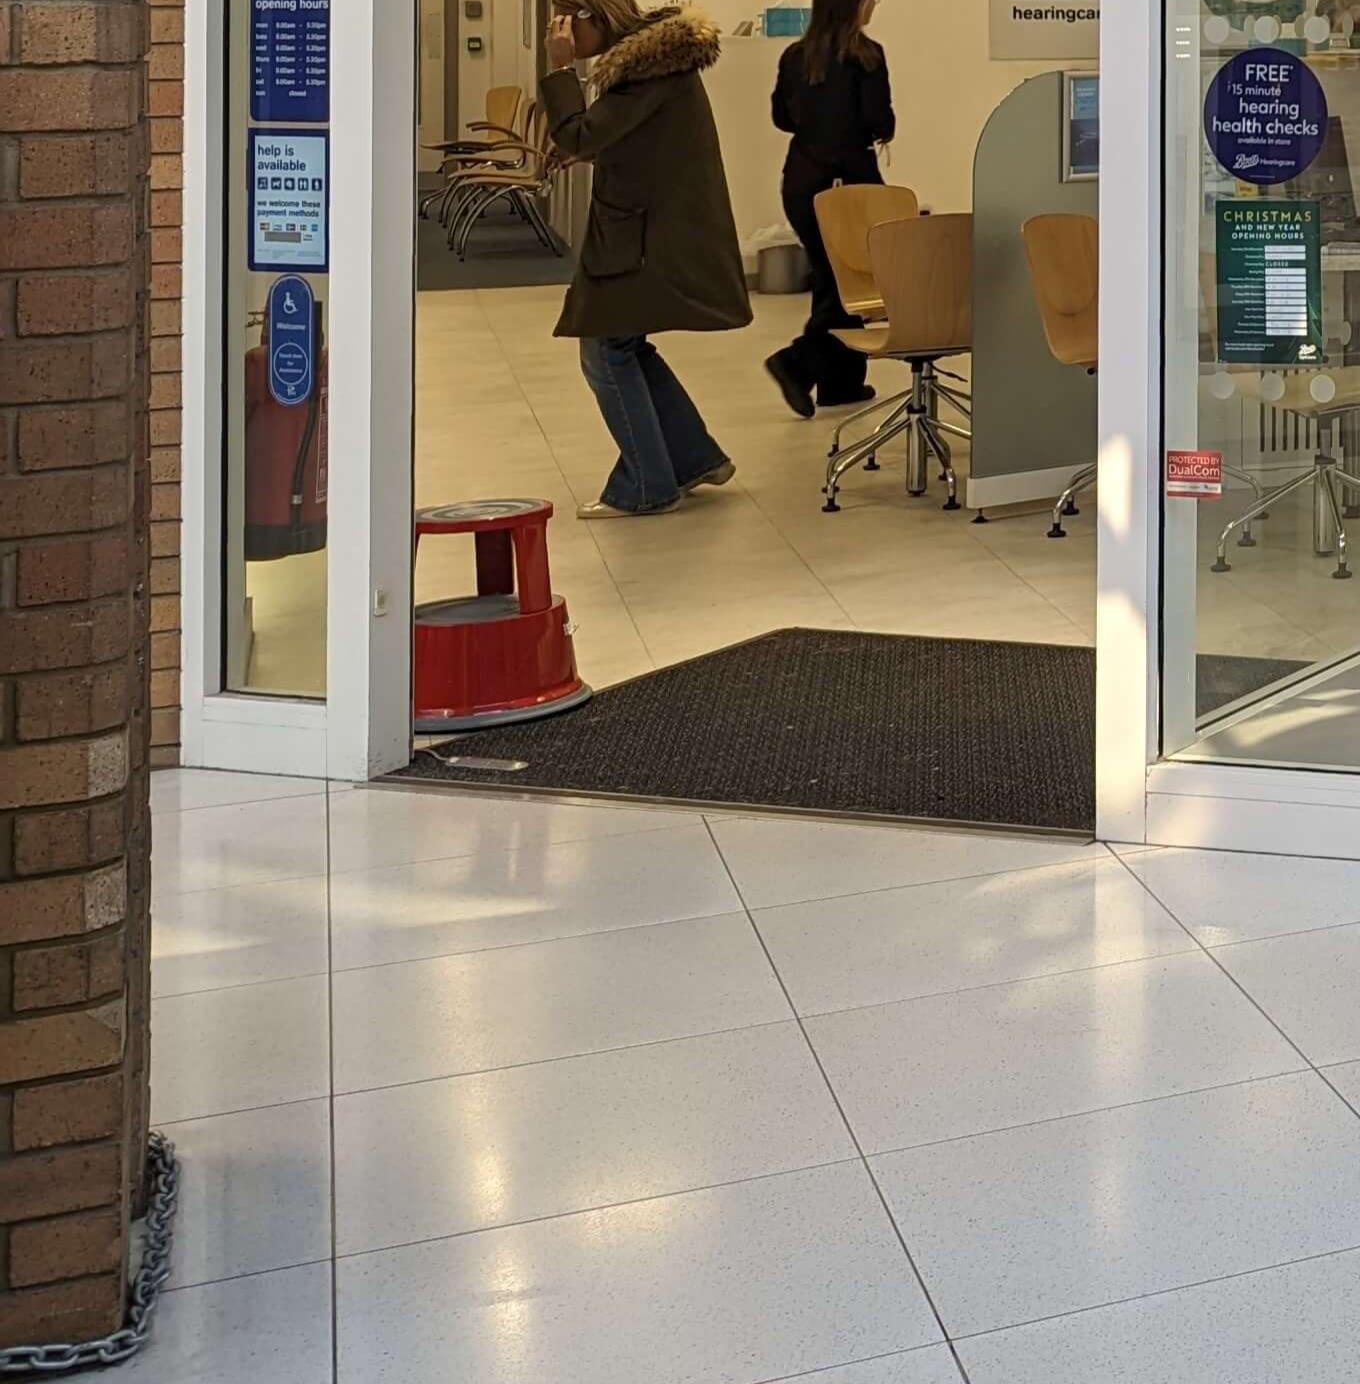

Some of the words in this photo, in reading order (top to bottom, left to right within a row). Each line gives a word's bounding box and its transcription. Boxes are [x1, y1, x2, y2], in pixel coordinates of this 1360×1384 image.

[1232, 83, 1243, 96] 15
[1244, 83, 1281, 97] minute
[1238, 97, 1300, 120] hearing
[1212, 116, 1262, 135] health
[1265, 116, 1319, 136] checks
[256, 143, 282, 158] help
[284, 144, 295, 157] is
[256, 158, 307, 172] available
[268, 199, 300, 208] welcome
[301, 200, 321, 208] these
[256, 209, 287, 218] payment
[288, 209, 319, 218] methods
[1223, 210, 1313, 223] CHRISTMAS
[1234, 223, 1254, 232] AND
[1256, 223, 1276, 232] NEW
[1278, 223, 1301, 232] YEAR
[1231, 231, 1272, 240] OPENING
[1274, 231, 1305, 240] HOURS
[1168, 455, 1210, 465] PROTECTED
[1168, 463, 1220, 476] DualCom
